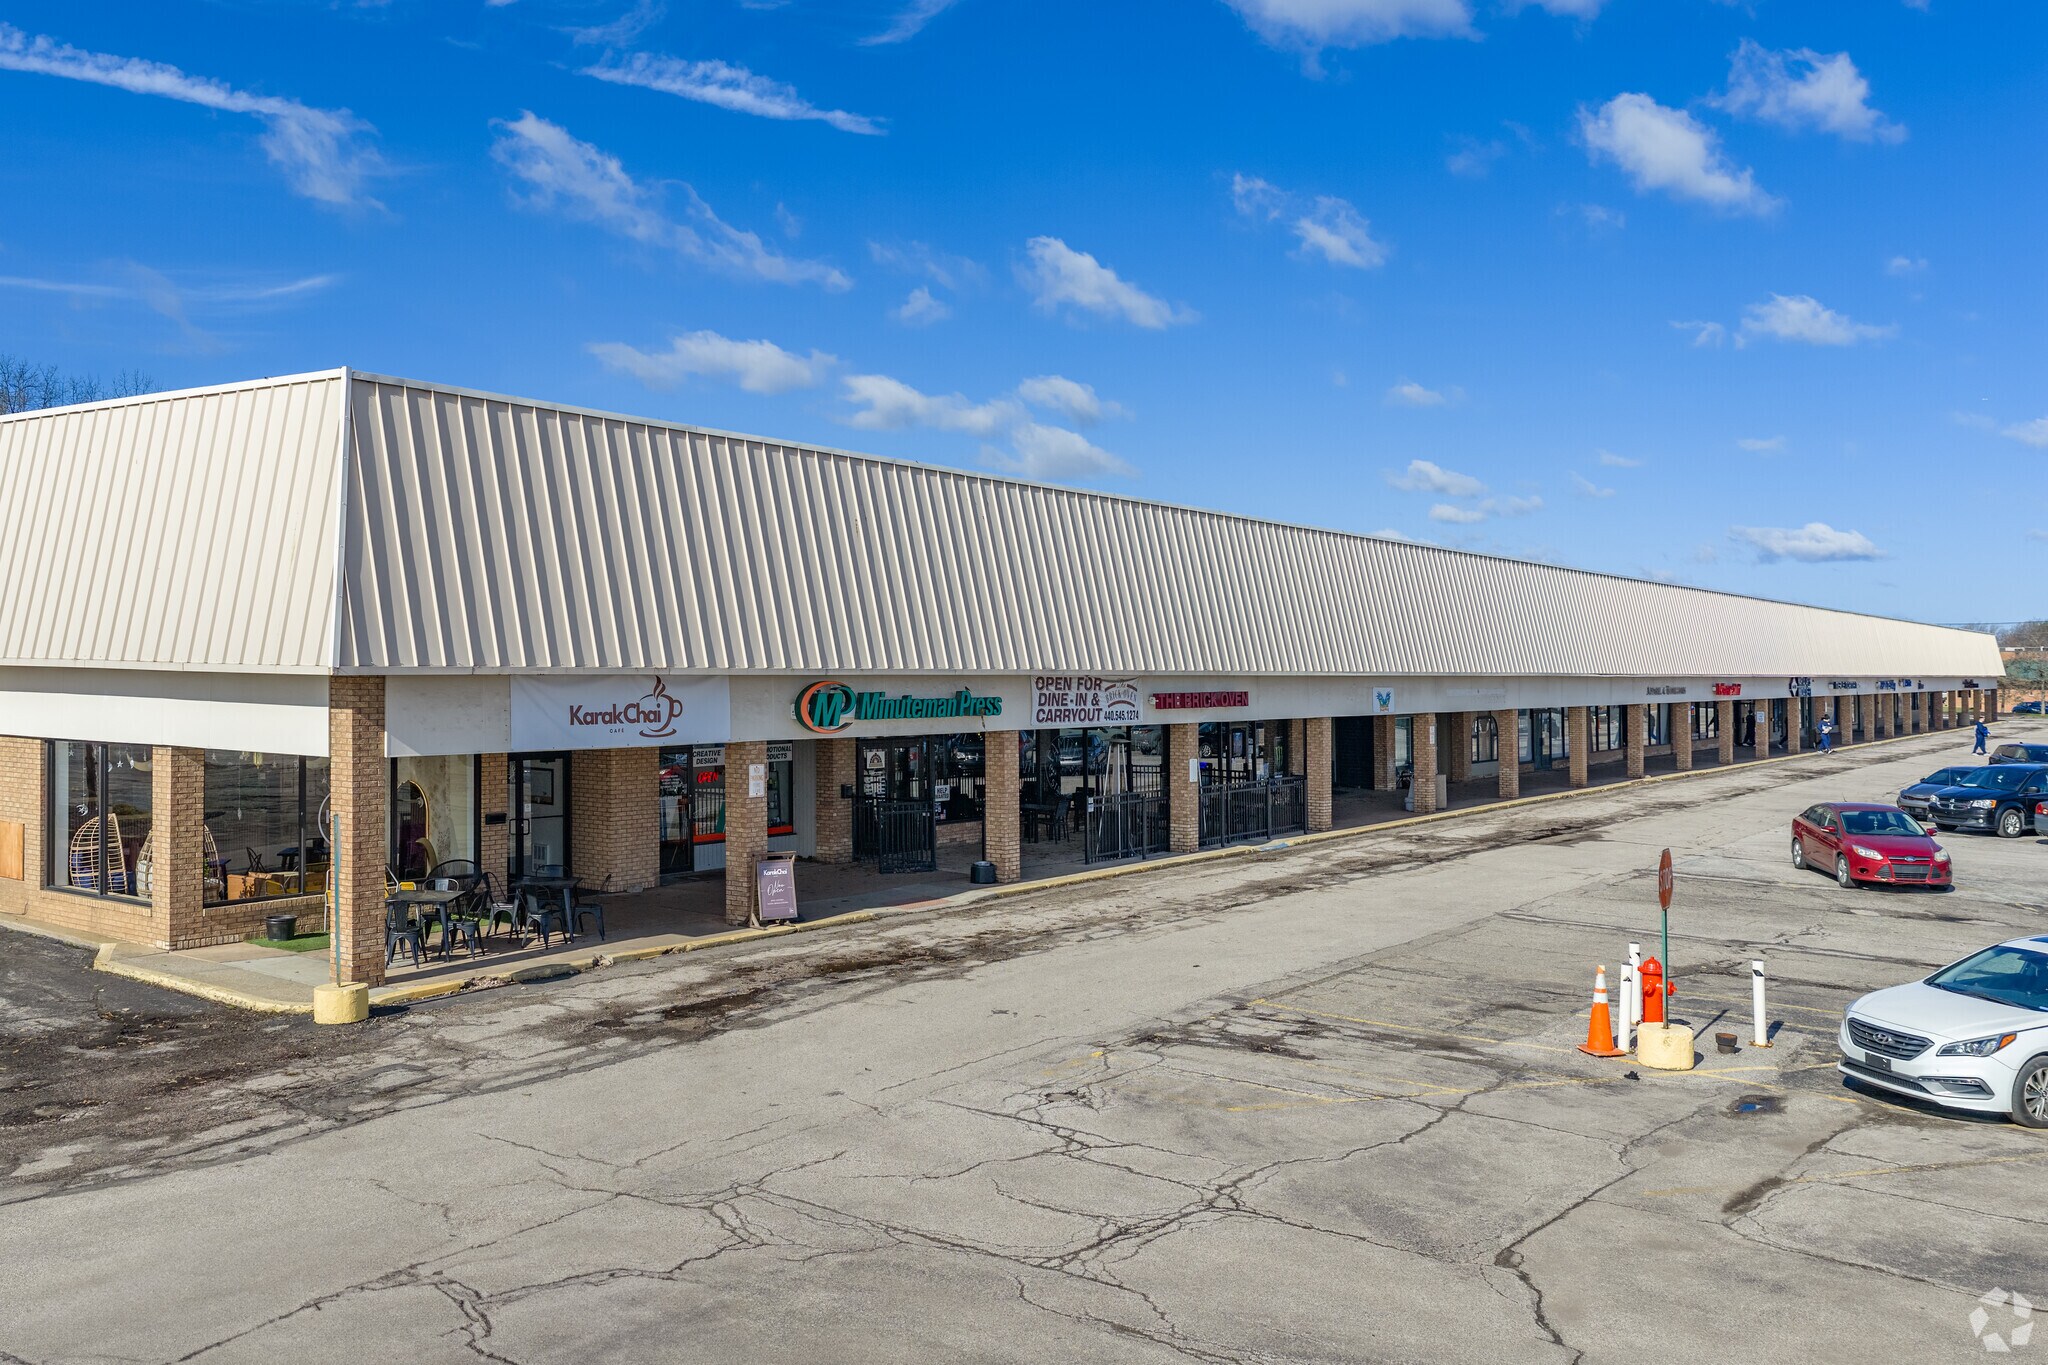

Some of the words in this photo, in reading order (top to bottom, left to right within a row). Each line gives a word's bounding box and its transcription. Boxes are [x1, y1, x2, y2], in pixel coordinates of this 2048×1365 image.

[1035, 676, 1072, 691] OPEN
[1077, 676, 1103, 691] FOR
[856, 691, 957, 719] Minuteman
[957, 690, 1002, 716] Press
[1038, 692, 1088, 707] DINE-IN
[1091, 692, 1100, 706] &
[1157, 694, 1180, 708] THE
[1184, 692, 1217, 708] BRICK
[1220, 691, 1249, 707] OVEN
[569, 702, 662, 725] KarakChai
[1036, 708, 1103, 723] CARRYOUT
[1104, 710, 1139, 721] 440.545.1274
[693, 750, 721, 758] CREATIVE
[696, 757, 718, 765] DESIGN
[697, 771, 719, 785] OPEN
